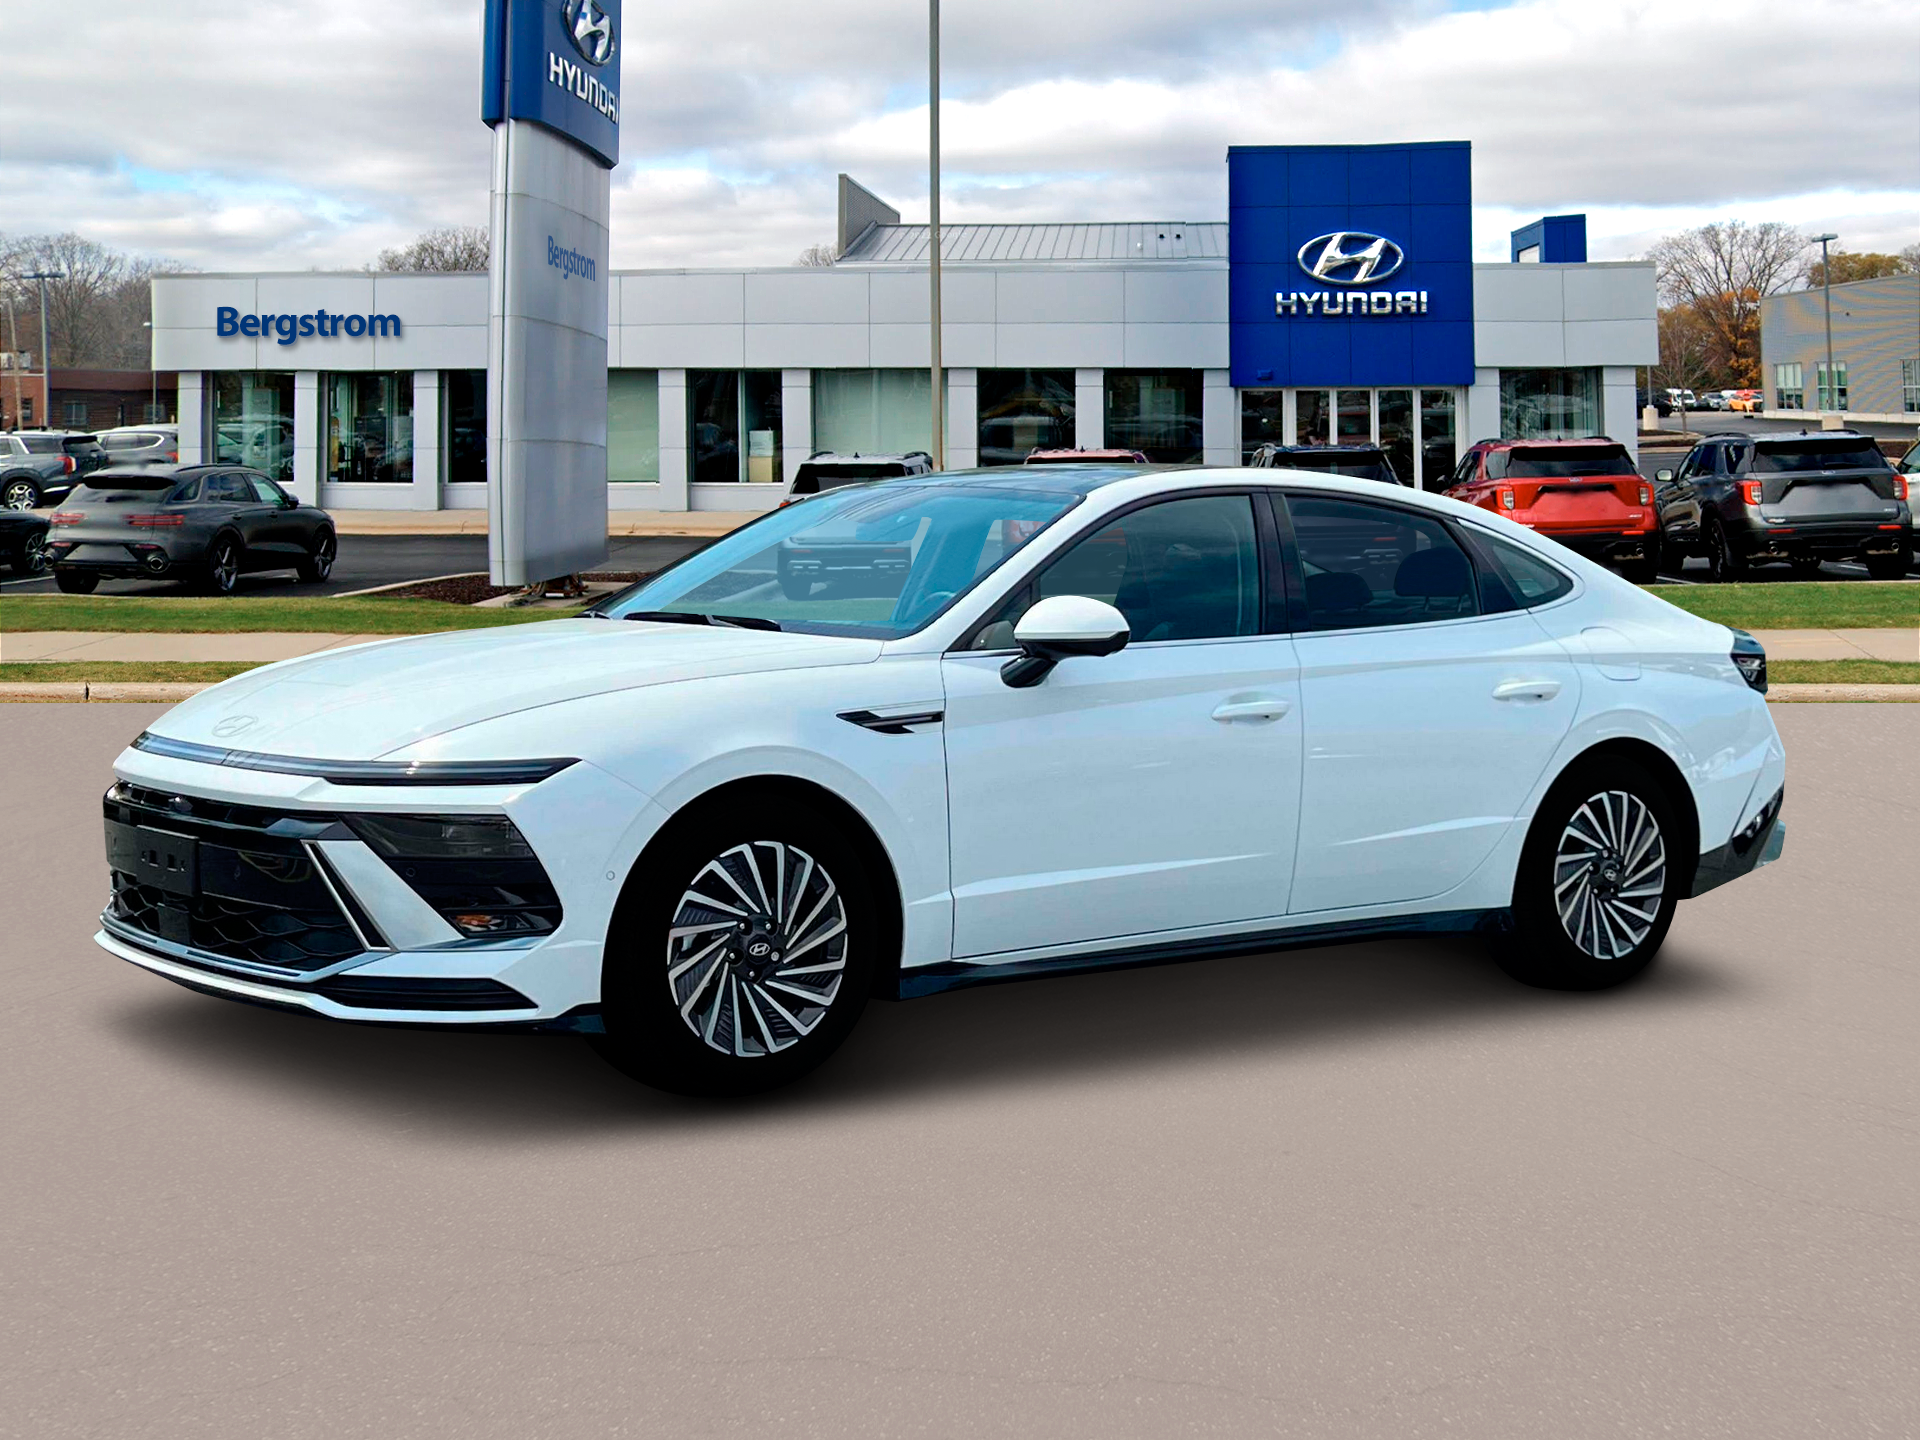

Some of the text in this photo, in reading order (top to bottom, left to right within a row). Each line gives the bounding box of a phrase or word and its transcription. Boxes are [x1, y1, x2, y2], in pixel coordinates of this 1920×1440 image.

[549, 52, 619, 124] HYUNDAI
[547, 235, 596, 282] Bergstrom
[1275, 291, 1428, 315] HYUNDAI
[216, 306, 401, 346] Bergstrom
